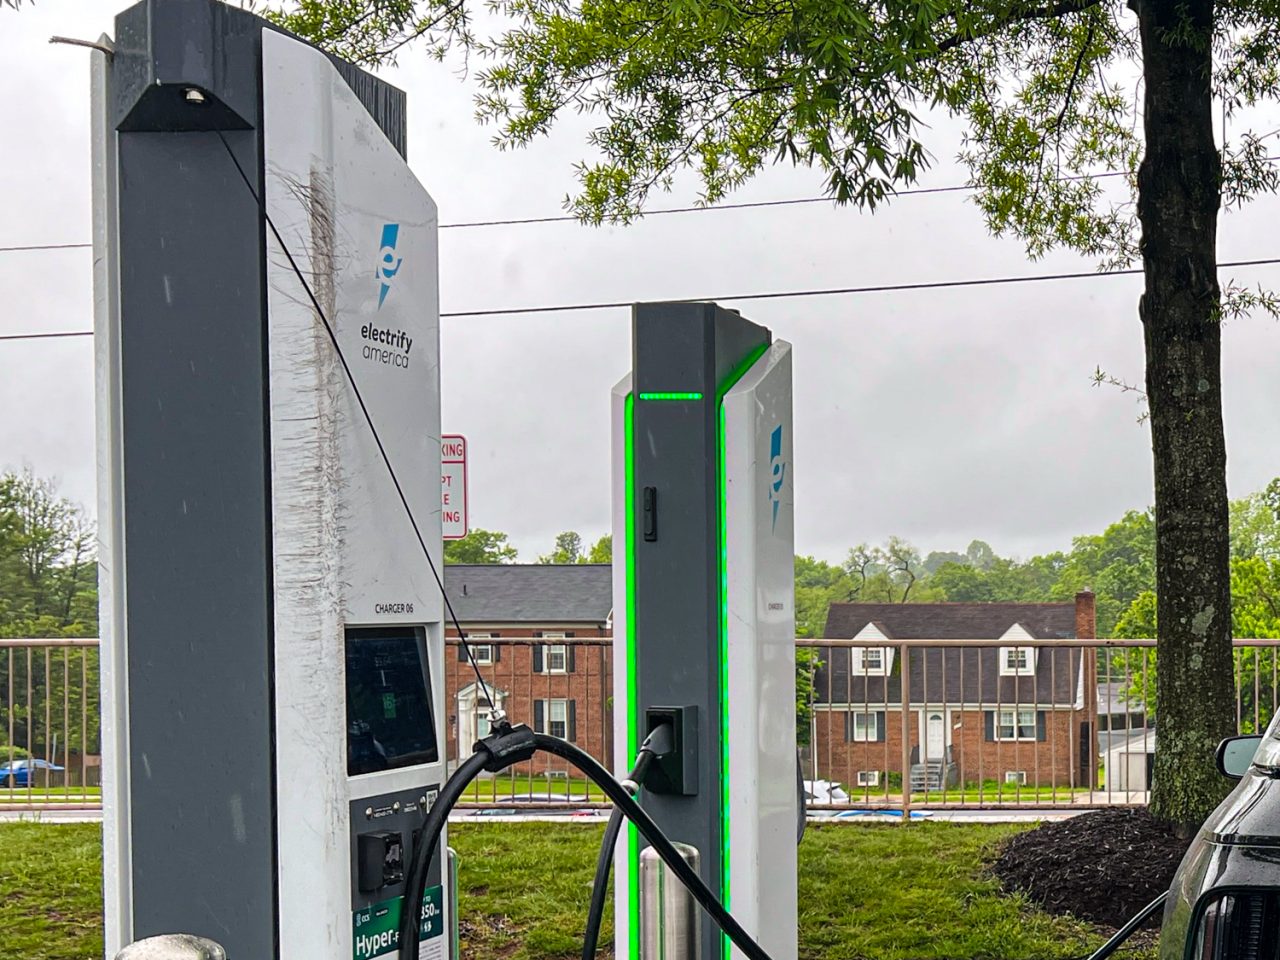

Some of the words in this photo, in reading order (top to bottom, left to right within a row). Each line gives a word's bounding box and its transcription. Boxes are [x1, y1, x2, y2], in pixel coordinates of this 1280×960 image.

[361, 322, 413, 353] electrify
[362, 344, 409, 369] america
[375, 603, 405, 614] CHARGER
[406, 603, 414, 613] 06
